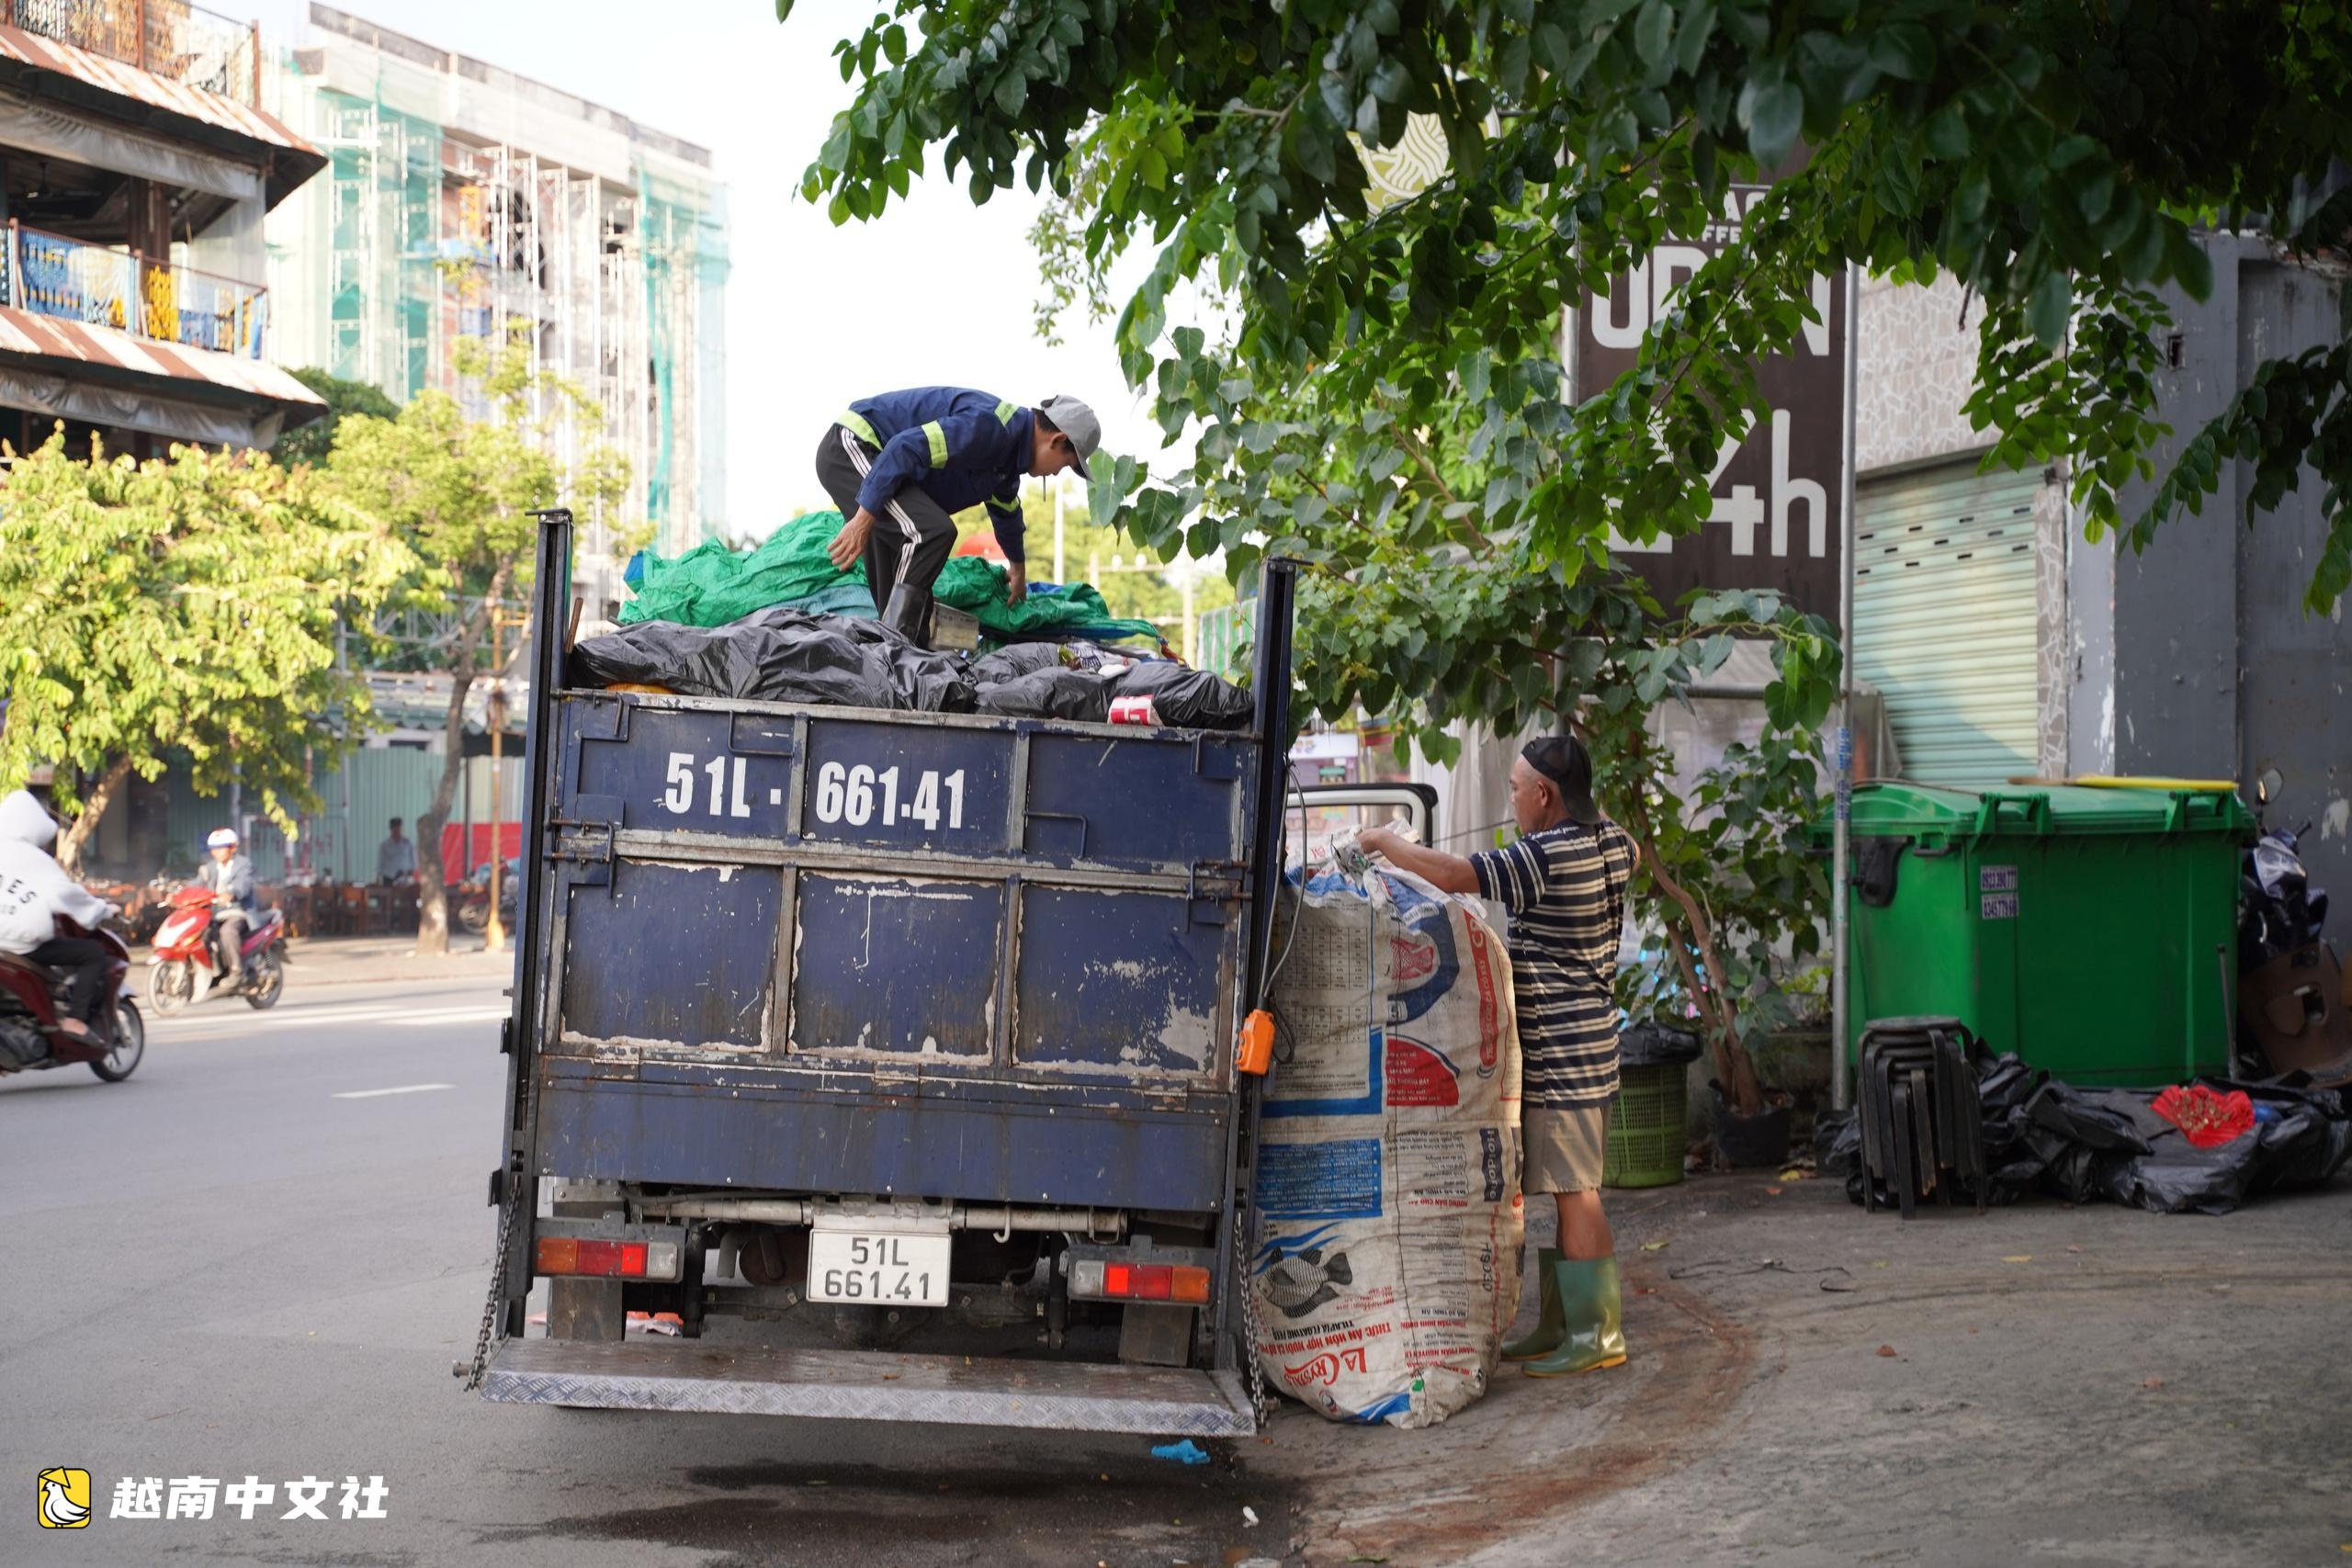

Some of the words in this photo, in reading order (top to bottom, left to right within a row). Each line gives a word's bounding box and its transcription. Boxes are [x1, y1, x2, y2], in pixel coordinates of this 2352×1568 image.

[816, 761, 966, 831] 661.41
[851, 1236, 909, 1267] 51L
[824, 1269, 930, 1300] 661.41
[1288, 1325, 1320, 1337] FLOATING
[1322, 1320, 1355, 1331] TILAPIA
[1348, 1328, 1363, 1342] ĂN
[1366, 1323, 1392, 1338] THỨC
[1307, 1337, 1323, 1349] HỢP
[1341, 1348, 1367, 1372] LA
[1283, 1355, 1341, 1386] CRYSTALS
